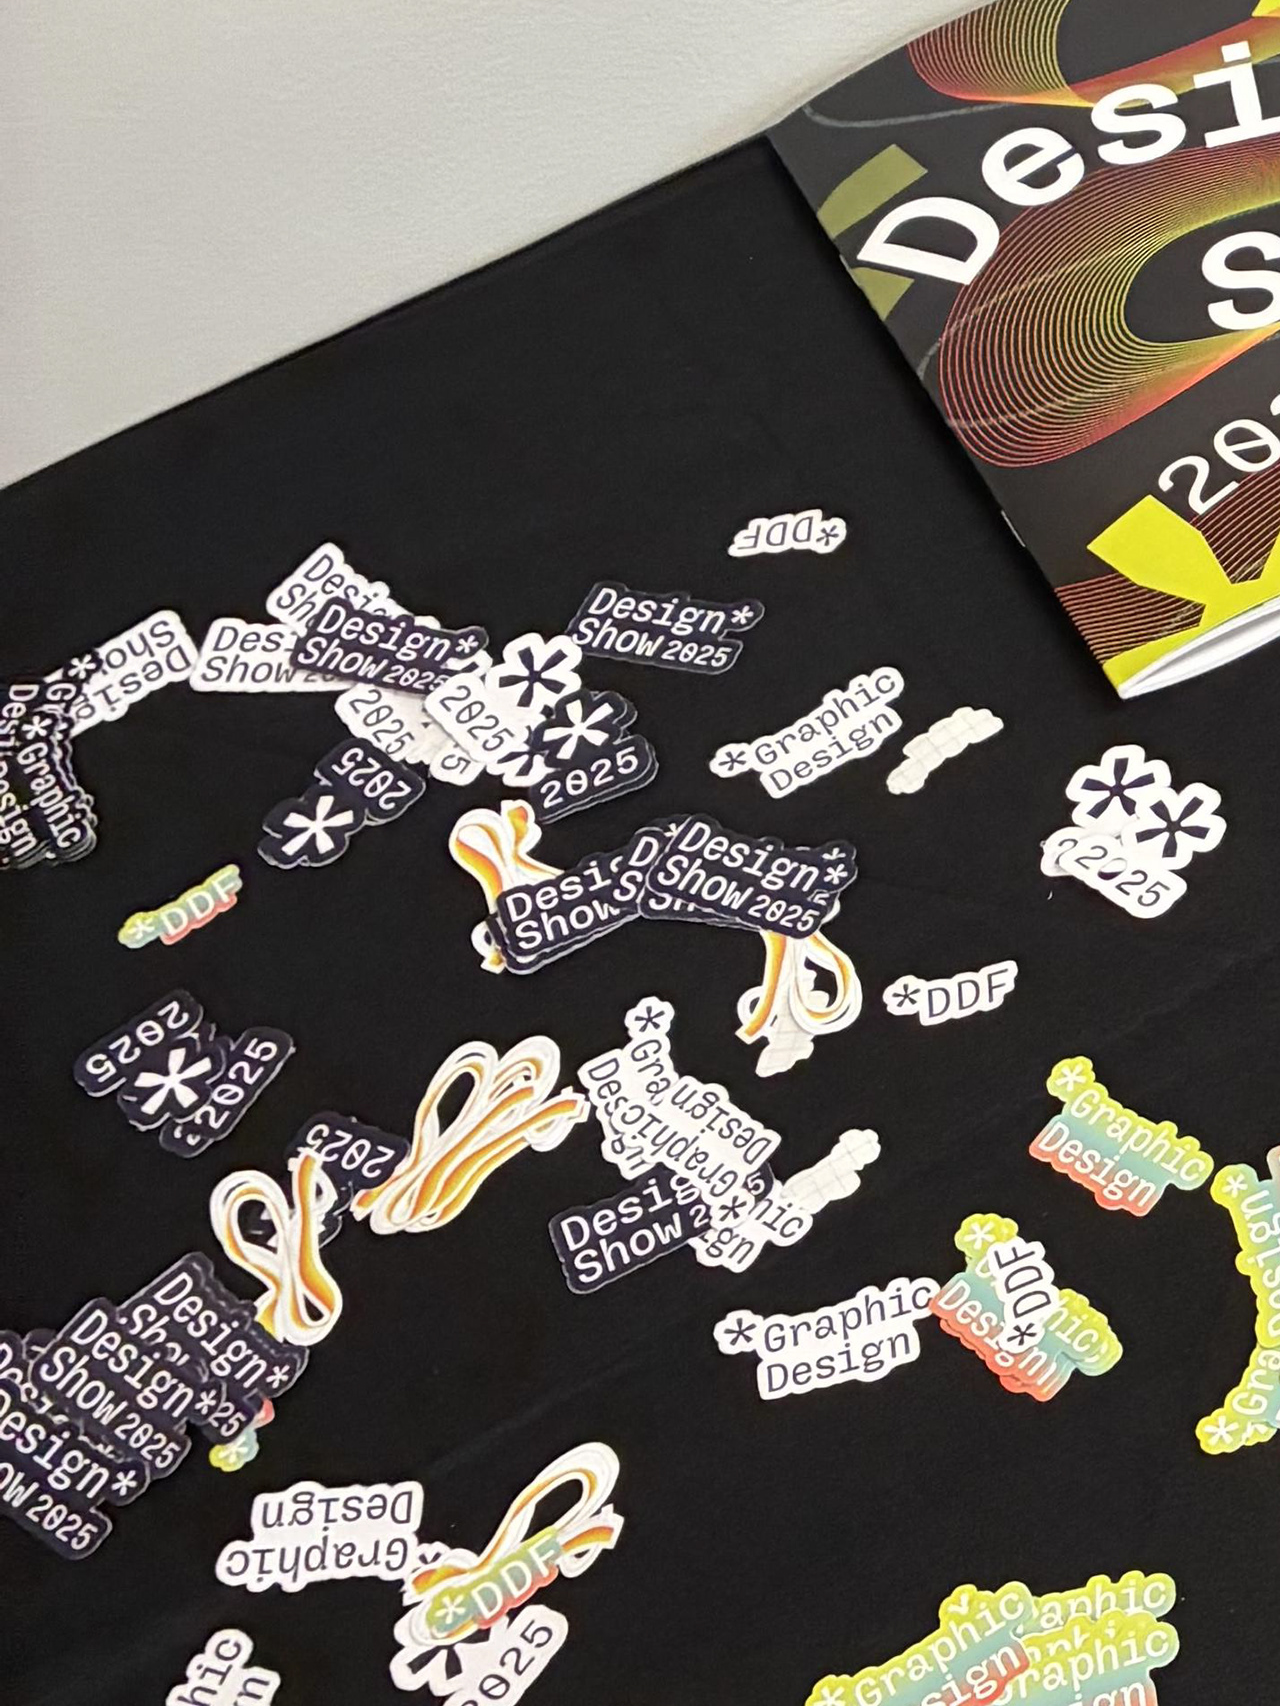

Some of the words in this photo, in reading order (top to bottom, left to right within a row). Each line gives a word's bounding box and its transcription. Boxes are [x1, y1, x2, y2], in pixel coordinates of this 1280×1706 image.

[297, 636, 388, 679] Show
[571, 616, 664, 657] Show
[661, 640, 734, 669] 2025
[348, 688, 415, 754] 2025
[439, 684, 516, 752] 2025
[770, 711, 894, 792] Design
[331, 746, 413, 811] 2025
[539, 746, 639, 809] 2025
[656, 854, 754, 911] Show
[747, 894, 826, 932] 2025
[85, 1000, 189, 1083] 2025
[195, 1036, 278, 1129] 2025
[669, 1081, 773, 1166] Design
[1037, 1120, 1158, 1208] Design
[573, 1211, 684, 1284] Show
[766, 1330, 911, 1393] Design
[40, 1344, 129, 1427] Show
[113, 1412, 181, 1470] 2025
[25, 1493, 99, 1551] 2025
[261, 1490, 413, 1528] Design
